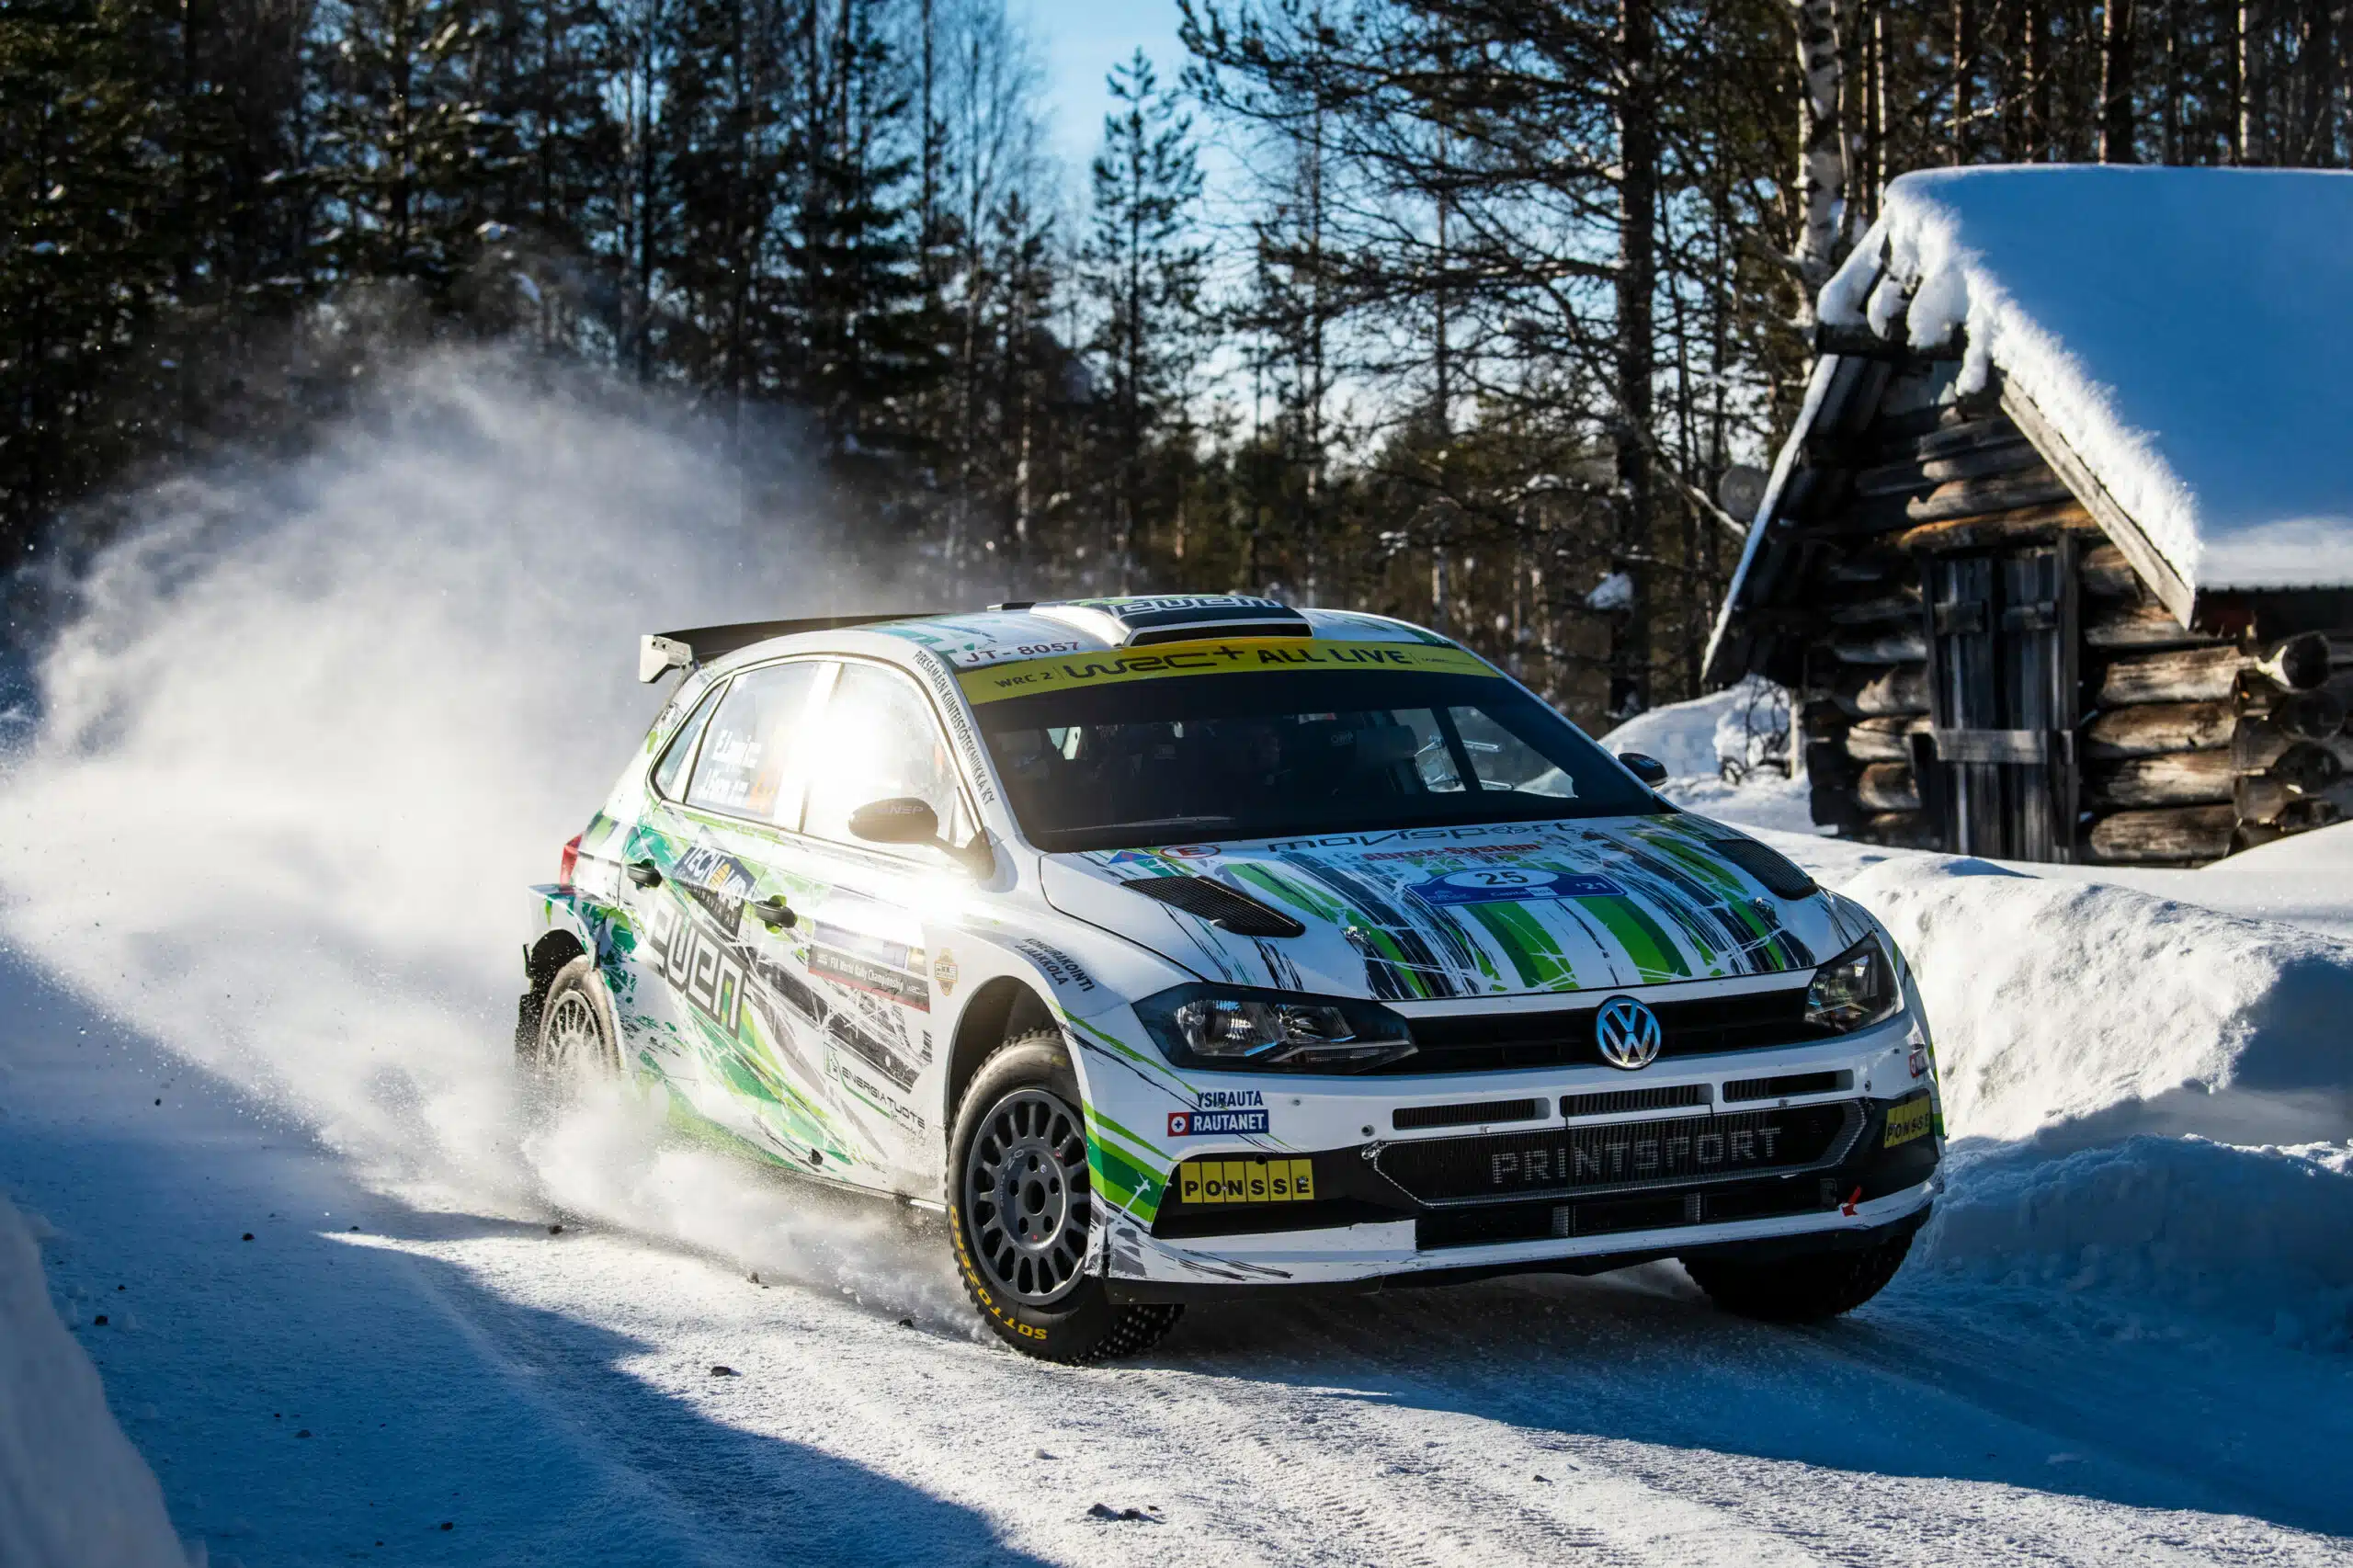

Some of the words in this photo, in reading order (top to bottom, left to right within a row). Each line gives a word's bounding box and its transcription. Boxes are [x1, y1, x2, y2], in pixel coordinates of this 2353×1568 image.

[966, 642, 1080, 663] JT-8057
[995, 672, 1038, 688] WRC
[1042, 671, 1053, 681] 2
[1257, 649, 1328, 664] ALL
[1329, 648, 1413, 665] LIVE
[981, 787, 995, 806] KY
[1474, 871, 1529, 885] 25
[1022, 937, 1096, 992] KONEURAKOINTI
[1197, 1090, 1265, 1108] YSIRAUTA
[1193, 1113, 1265, 1132] RAUTANET
[1885, 1110, 1930, 1141] PONSSE
[1492, 1127, 1782, 1184] PRINTSPORT
[1184, 1176, 1311, 1197] PONSSE
